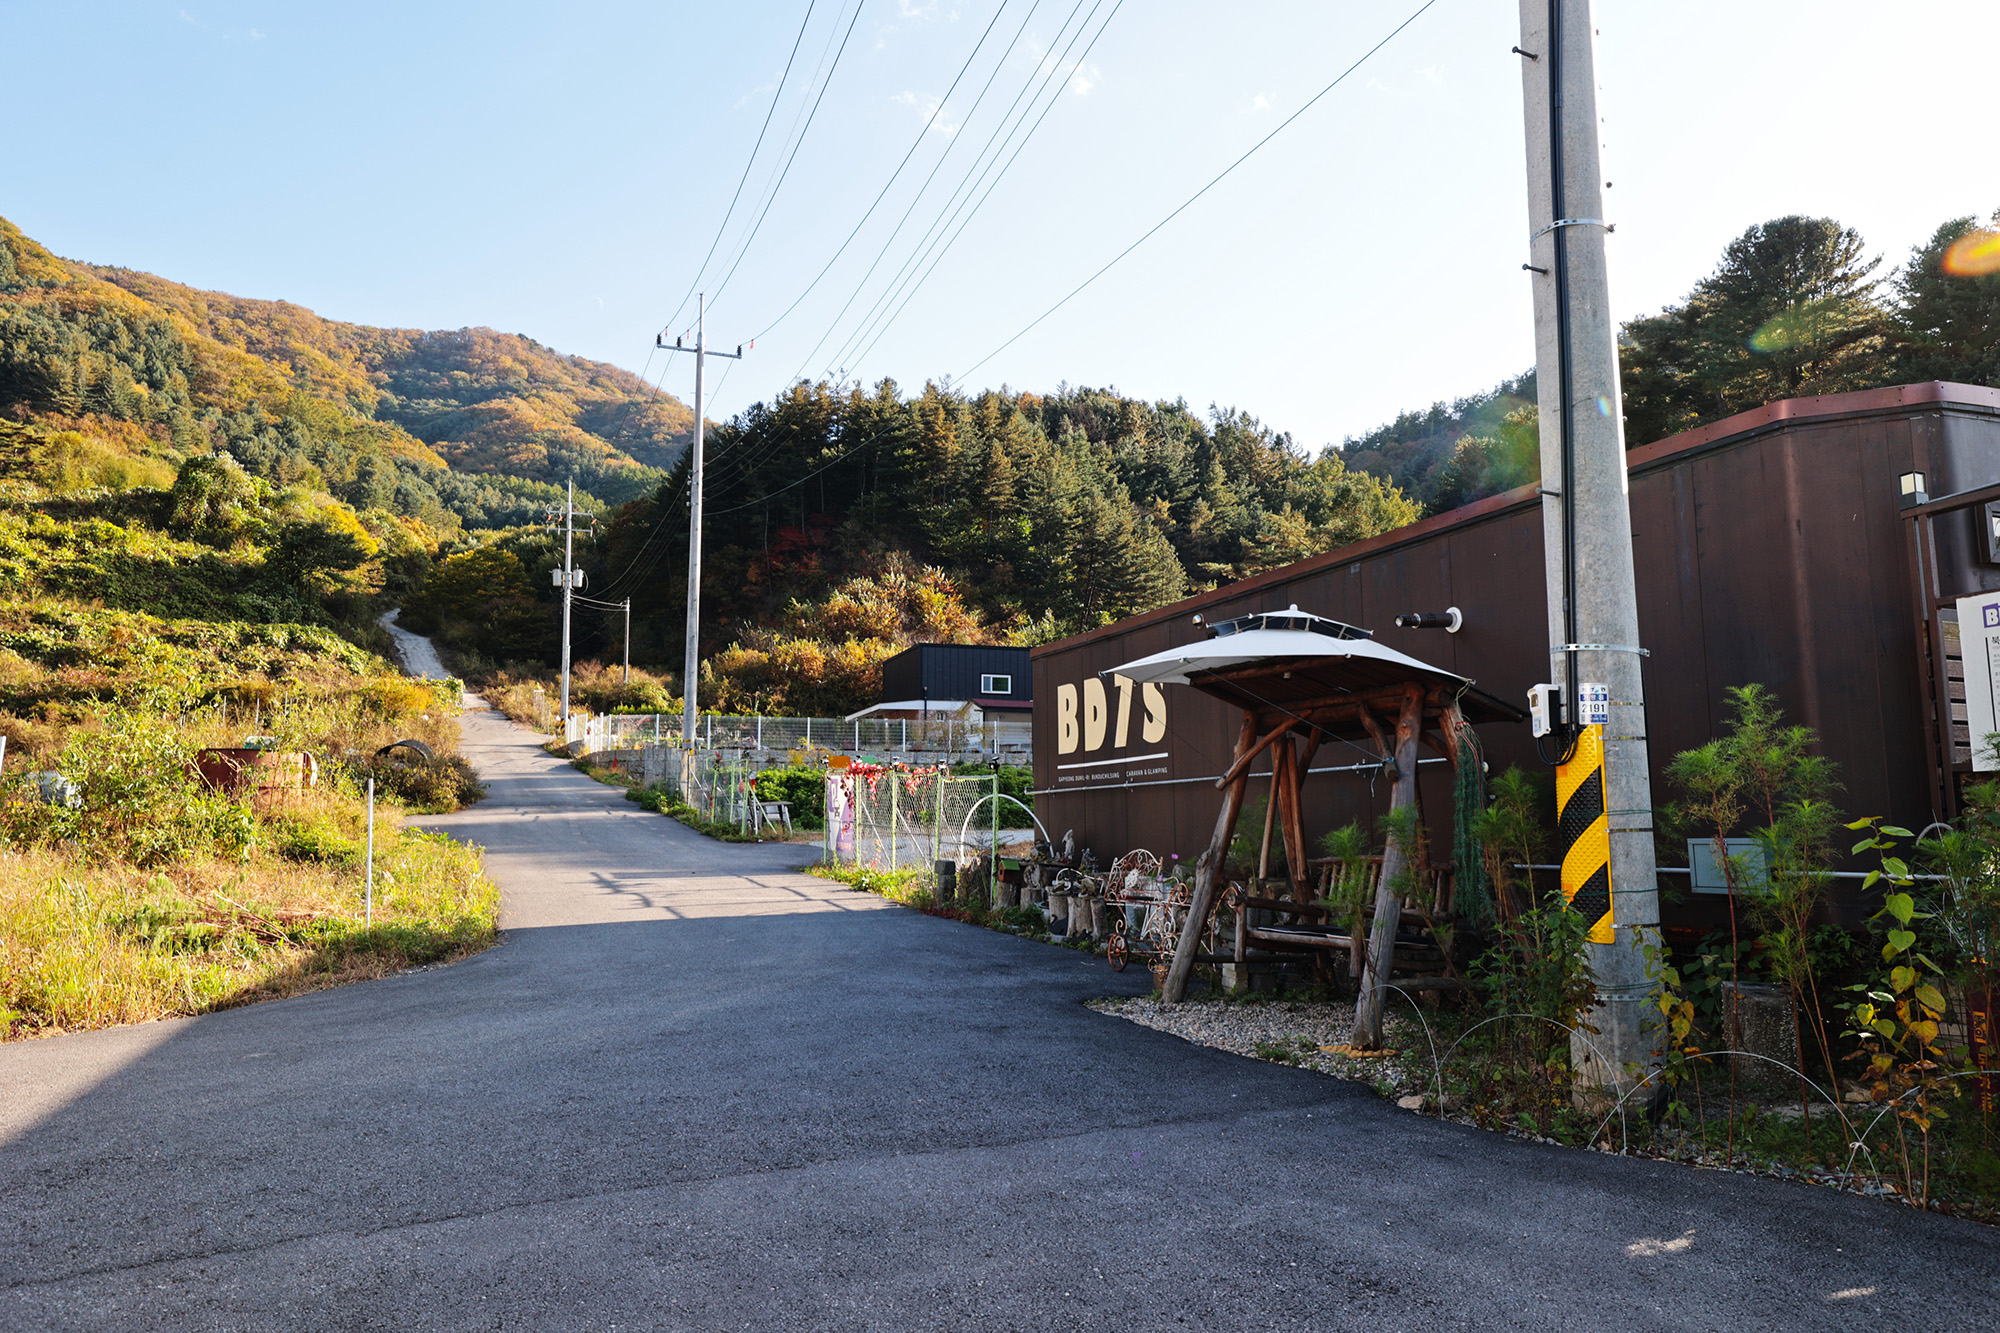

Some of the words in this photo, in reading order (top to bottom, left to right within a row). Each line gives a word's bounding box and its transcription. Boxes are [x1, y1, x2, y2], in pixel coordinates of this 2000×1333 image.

[1582, 703, 1605, 713] 2191
[1126, 769, 1143, 777] CARAVAN
[1148, 767, 1168, 775] GLAMPING
